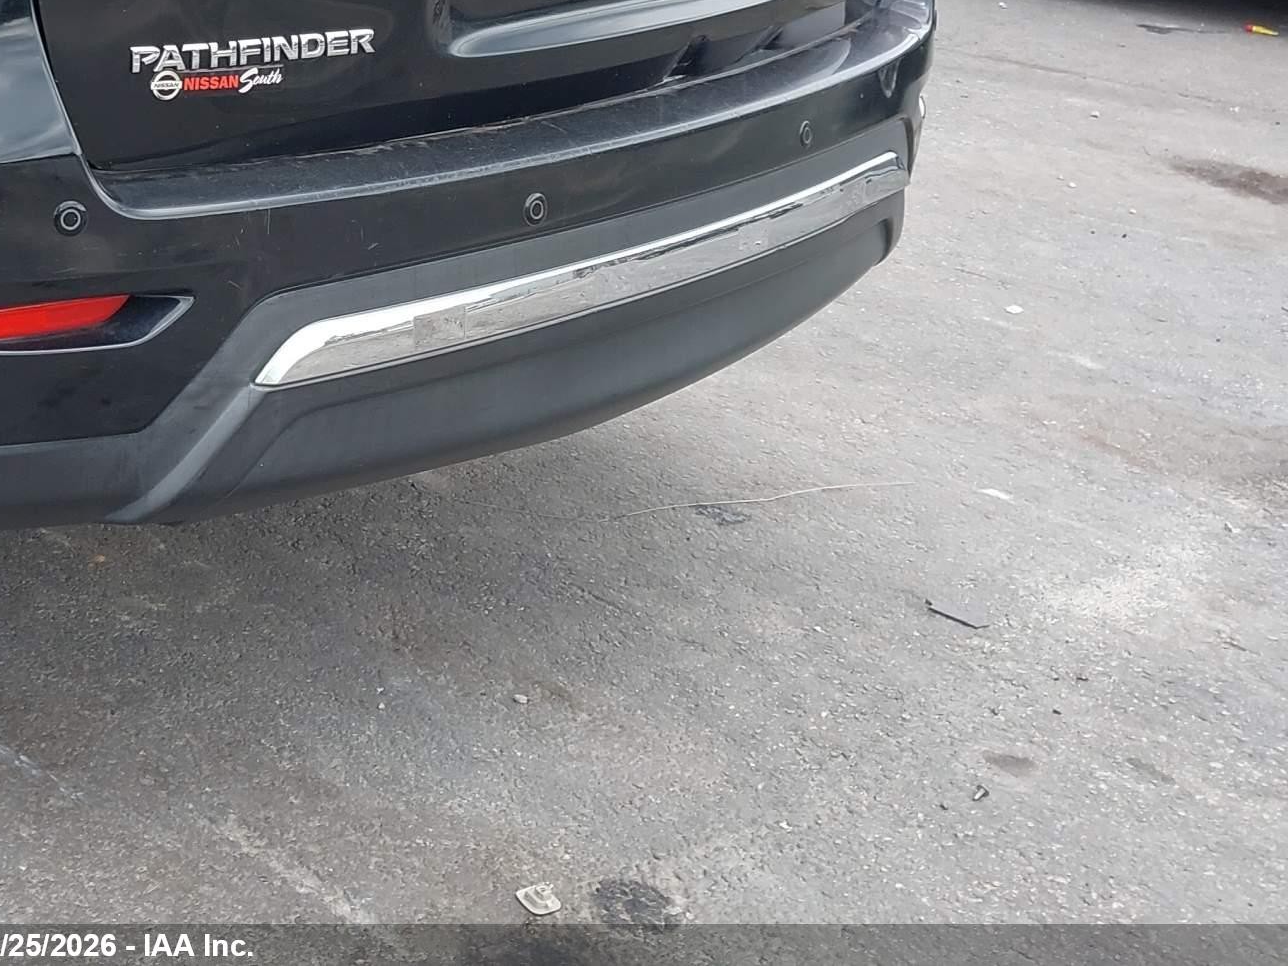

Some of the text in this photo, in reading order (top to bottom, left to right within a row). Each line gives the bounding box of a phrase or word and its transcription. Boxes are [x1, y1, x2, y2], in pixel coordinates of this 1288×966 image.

[129, 27, 377, 75] PATHFINDER
[183, 66, 283, 94] NISSAN South
